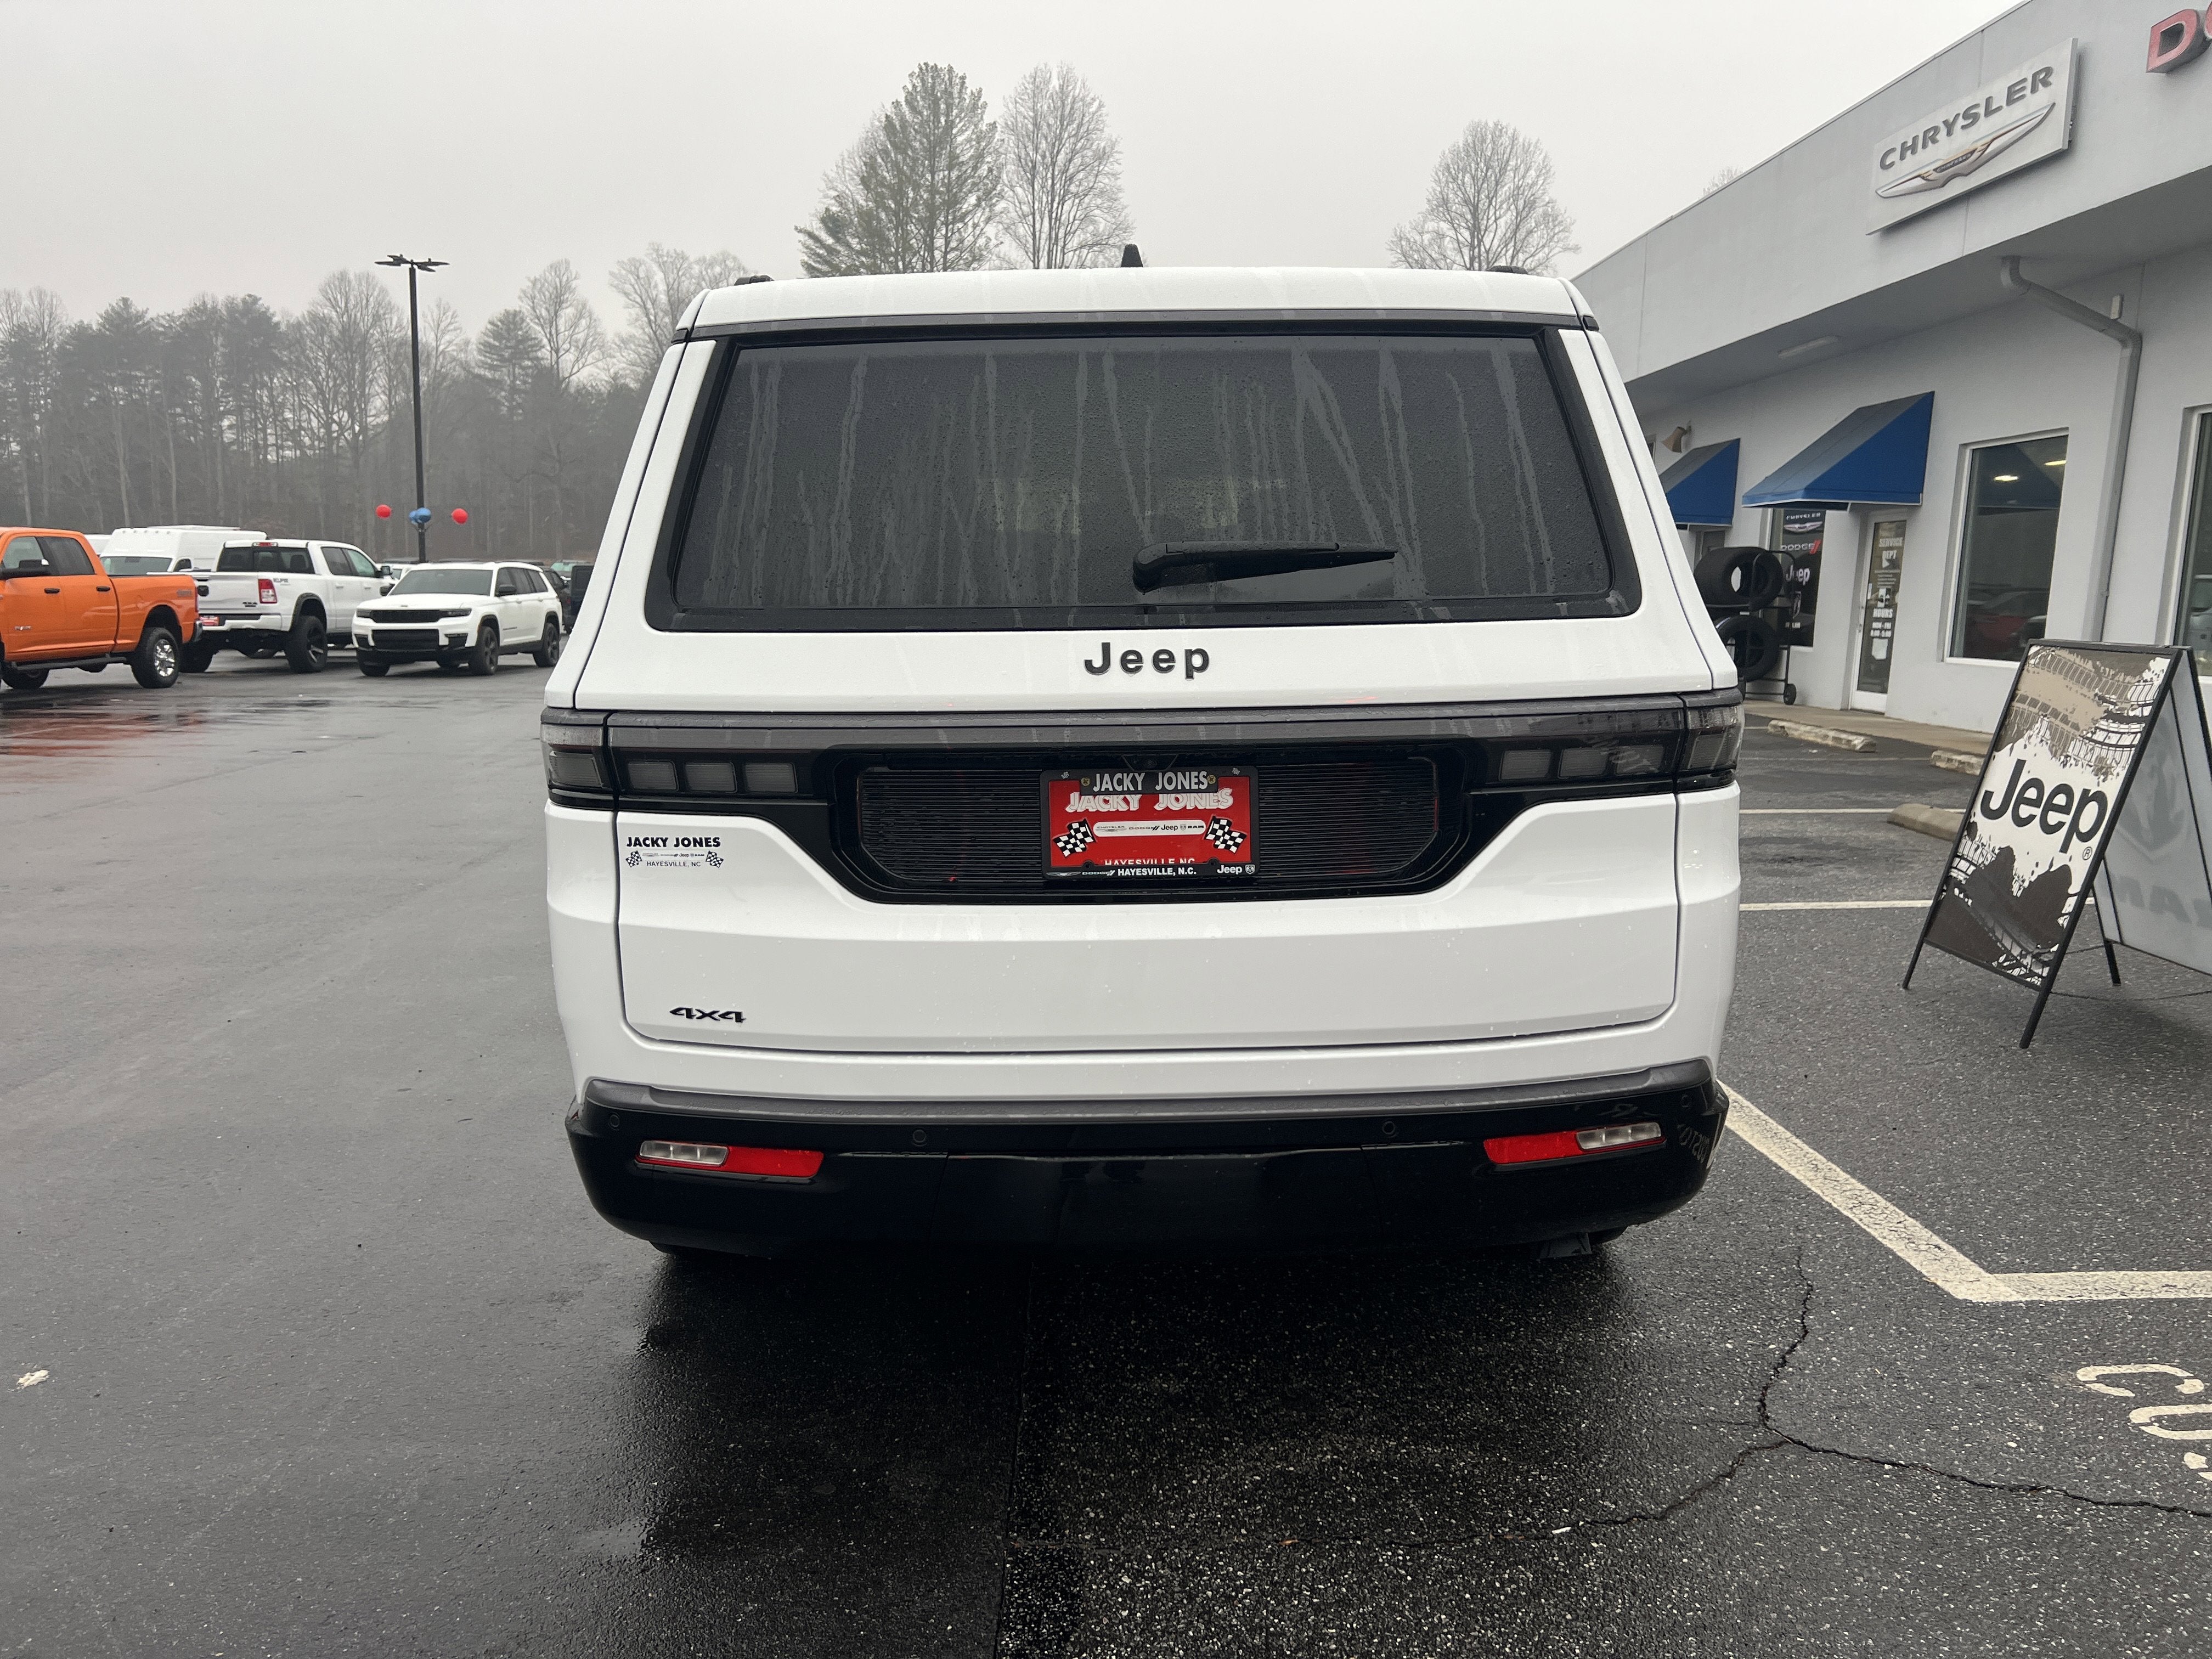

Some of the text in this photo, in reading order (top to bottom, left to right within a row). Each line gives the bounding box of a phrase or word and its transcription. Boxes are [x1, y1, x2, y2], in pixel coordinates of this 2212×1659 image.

[2146, 0, 2212, 73] D
[1880, 66, 2053, 170] CHRYSLER
[1780, 543, 1815, 551] DODGE
[1786, 564, 1810, 586] Jep
[1084, 642, 1209, 680] Jeep
[1093, 771, 1208, 792] JACKY JONES
[1065, 788, 1234, 812] JACKY JONES
[1980, 759, 2108, 853] Jeep
[626, 837, 721, 848] JACKY JONES
[1118, 868, 1176, 876] HAYESVILLE,
[1178, 867, 1197, 875] N.C.
[1217, 865, 1243, 874] Jeep
